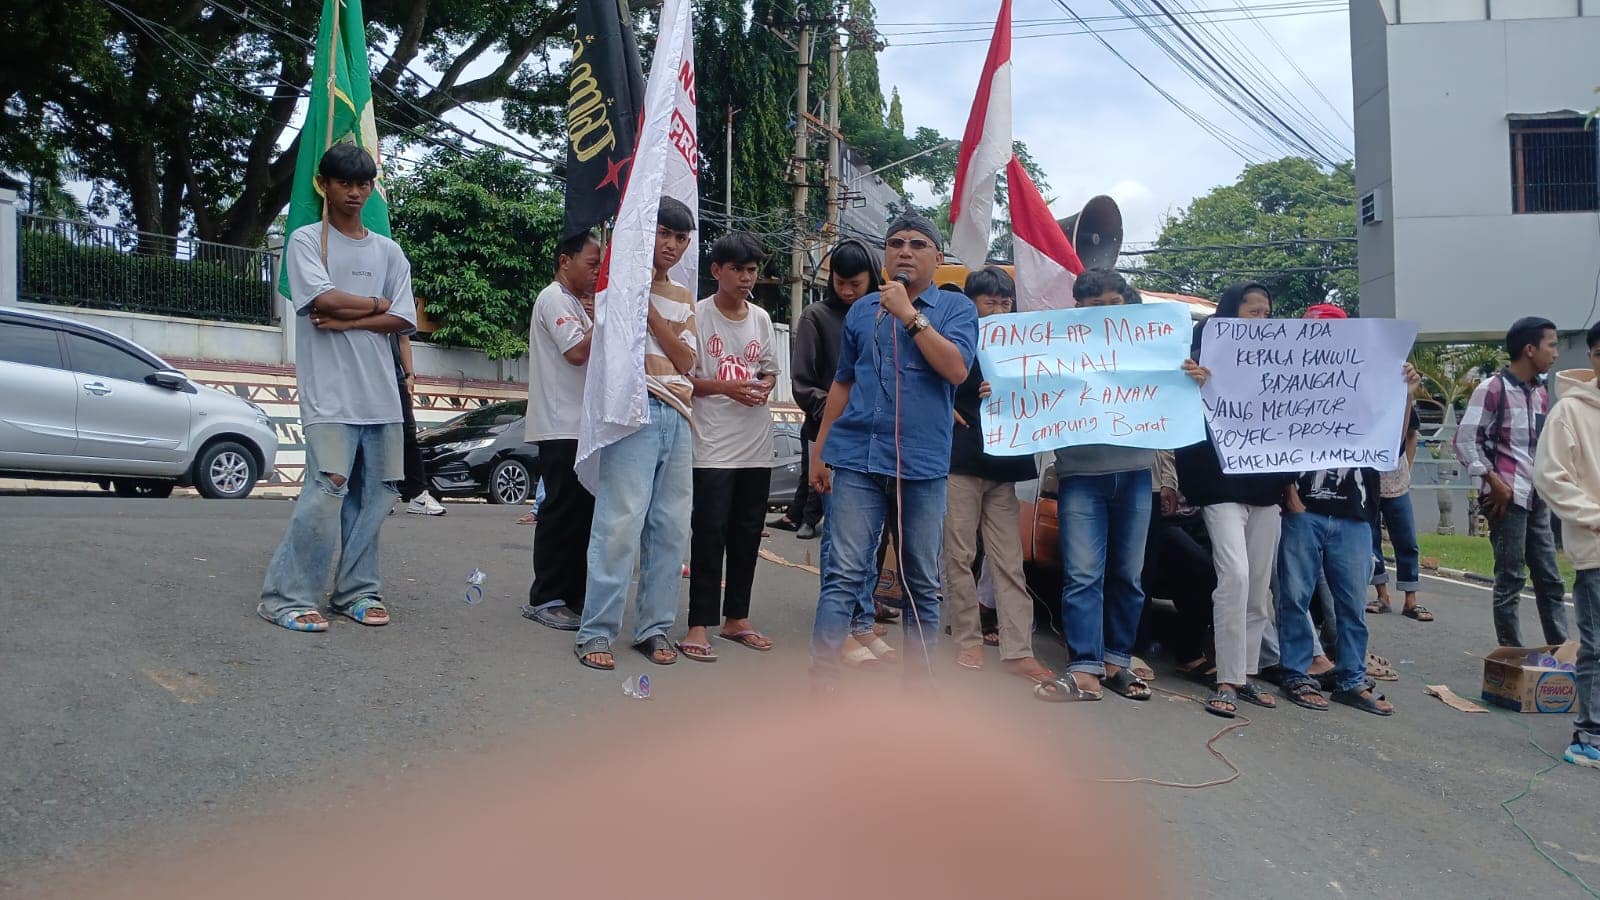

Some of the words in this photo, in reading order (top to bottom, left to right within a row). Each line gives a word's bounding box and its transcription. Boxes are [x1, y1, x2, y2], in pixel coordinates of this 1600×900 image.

[979, 320, 1092, 350] TANGKAP
[1215, 321, 1287, 342] DIDUGA
[1296, 322, 1332, 341] ADA
[997, 350, 1116, 389] TANAH
[1236, 348, 1293, 367] KEPALA
[1302, 348, 1365, 367] KANWIL
[1079, 382, 1158, 406] KANAN
[1258, 370, 1361, 396] BAYANGAN
[1202, 396, 1253, 423] YANG
[1262, 397, 1346, 421] MENGATUR
[1104, 411, 1170, 437] Barat
[1226, 449, 1303, 471] EMENAG
[1310, 448, 1390, 463] LAMPUNG
